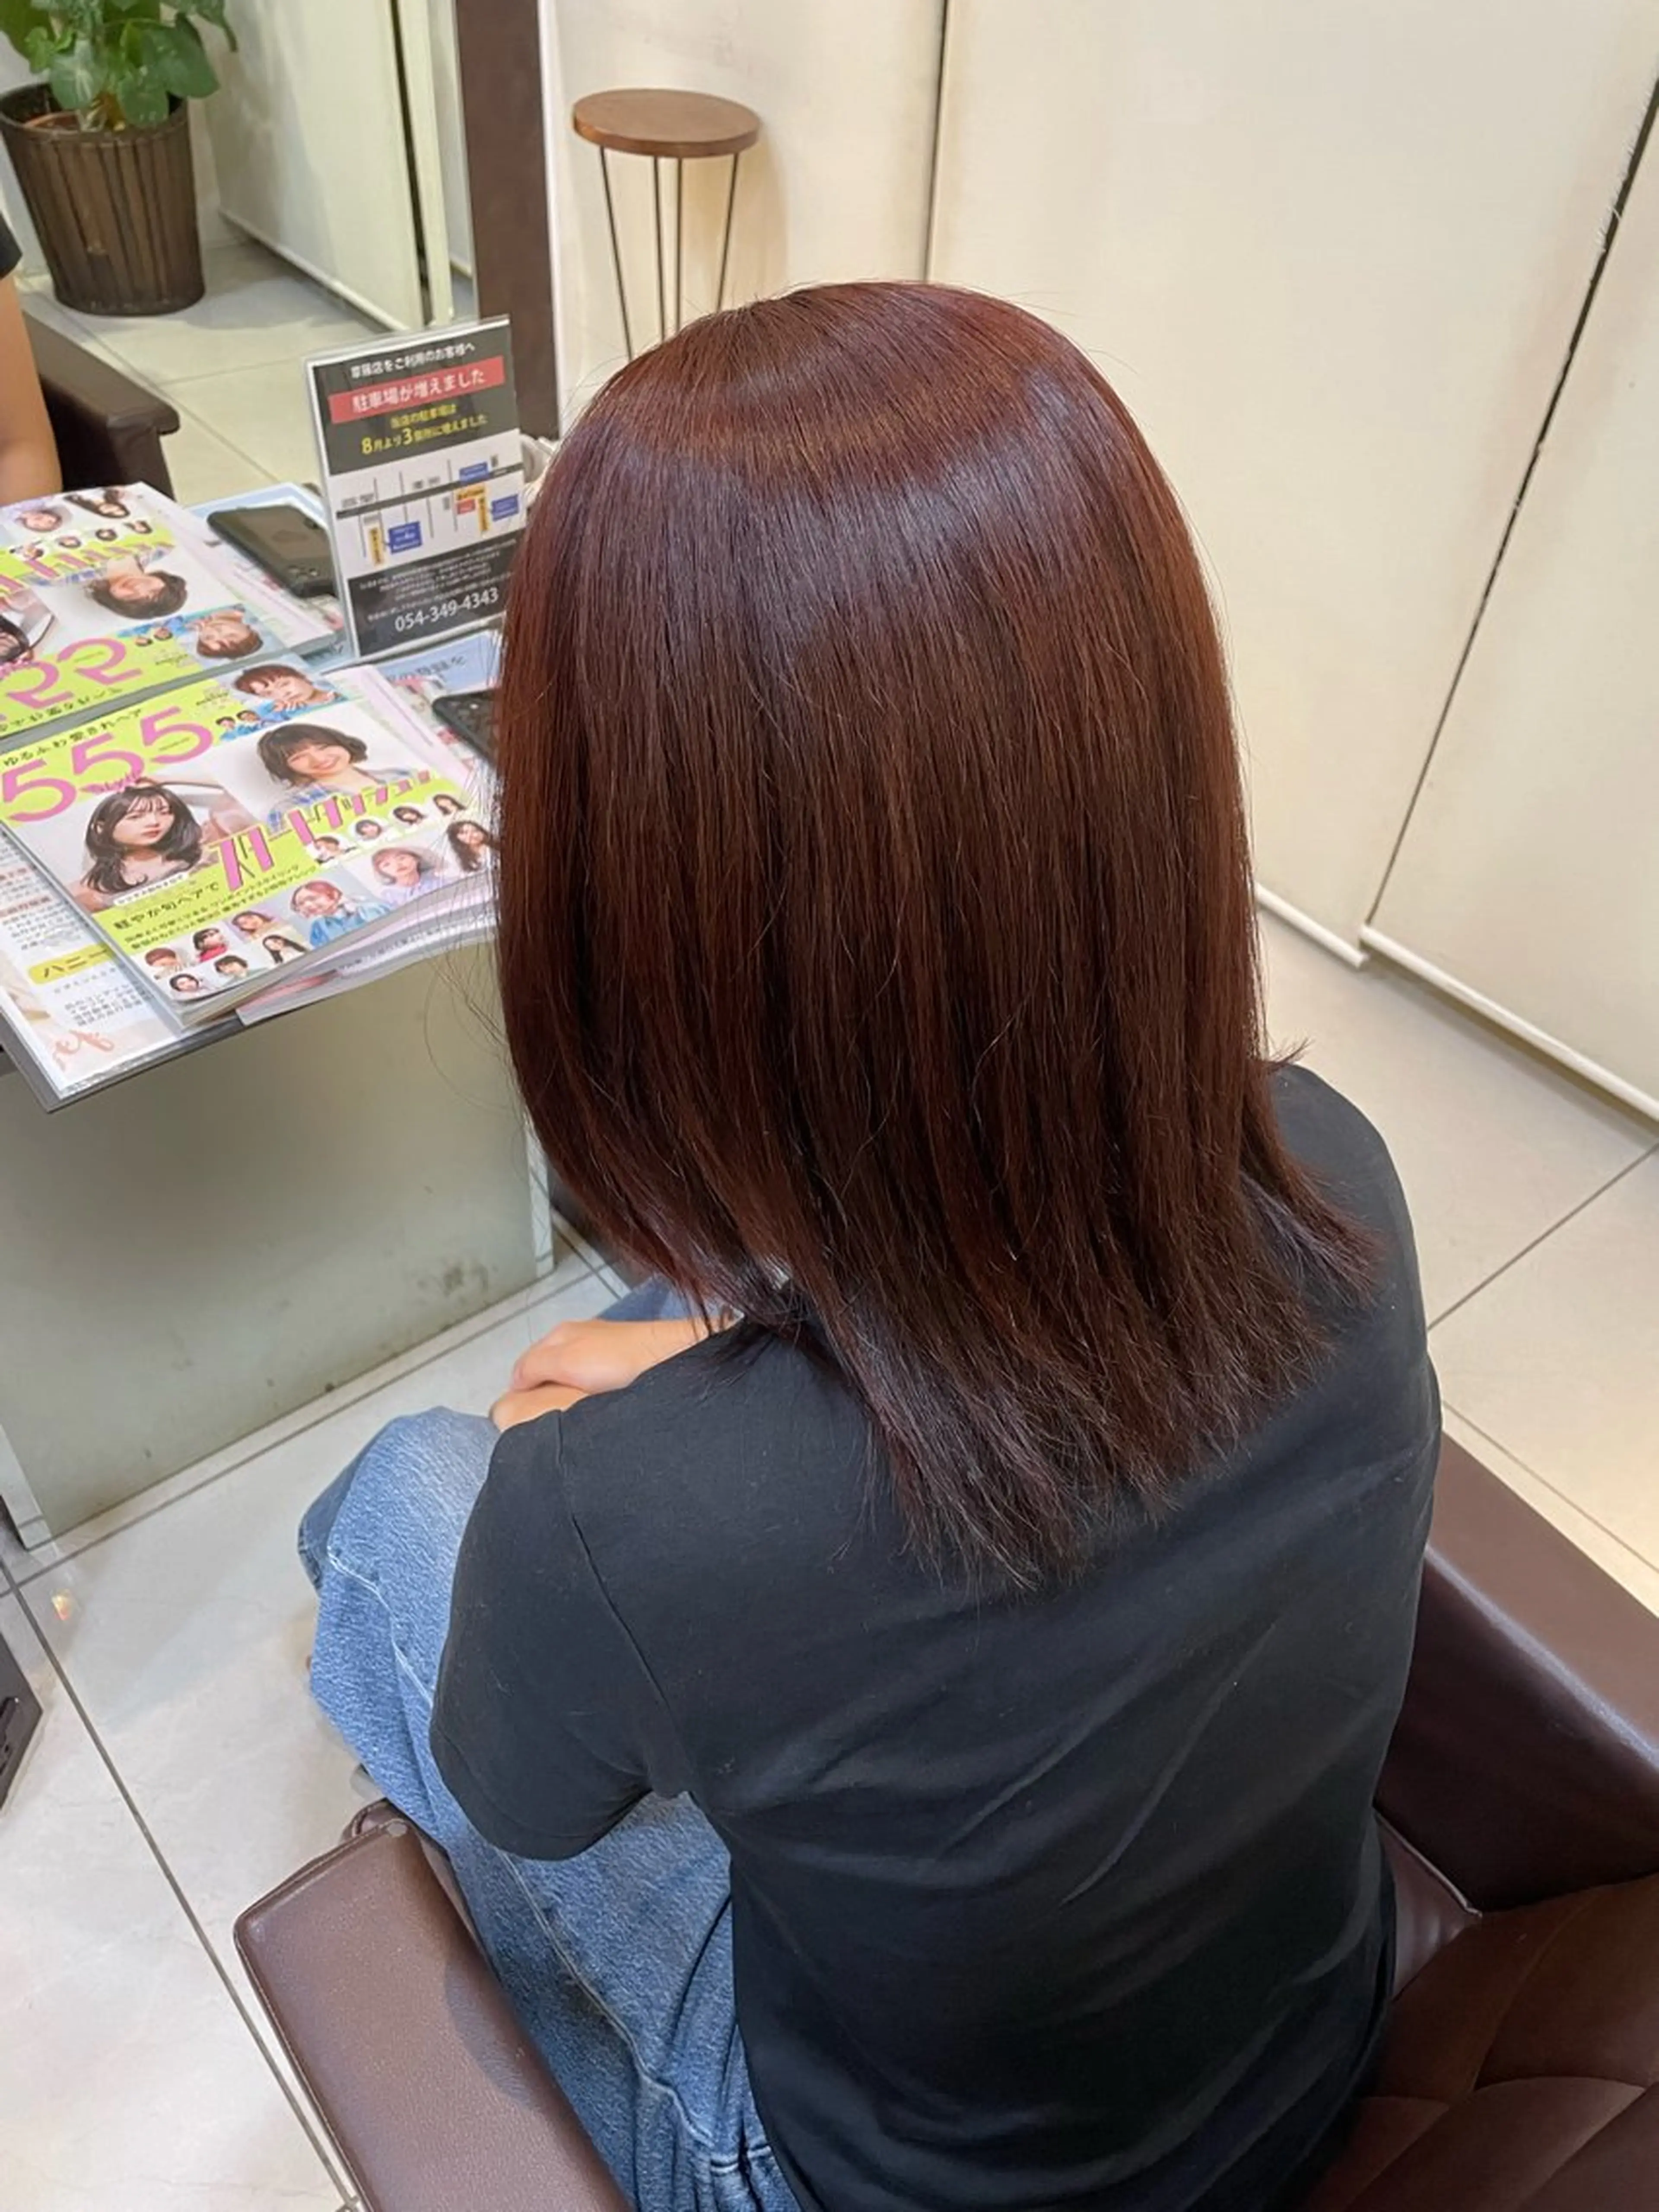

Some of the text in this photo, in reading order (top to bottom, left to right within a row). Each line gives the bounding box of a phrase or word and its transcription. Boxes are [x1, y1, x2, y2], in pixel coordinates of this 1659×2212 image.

[352, 369, 486, 413] 駐車場が増えました
[395, 587, 499, 632] 054-349-4343
[1, 706, 213, 822] 555
